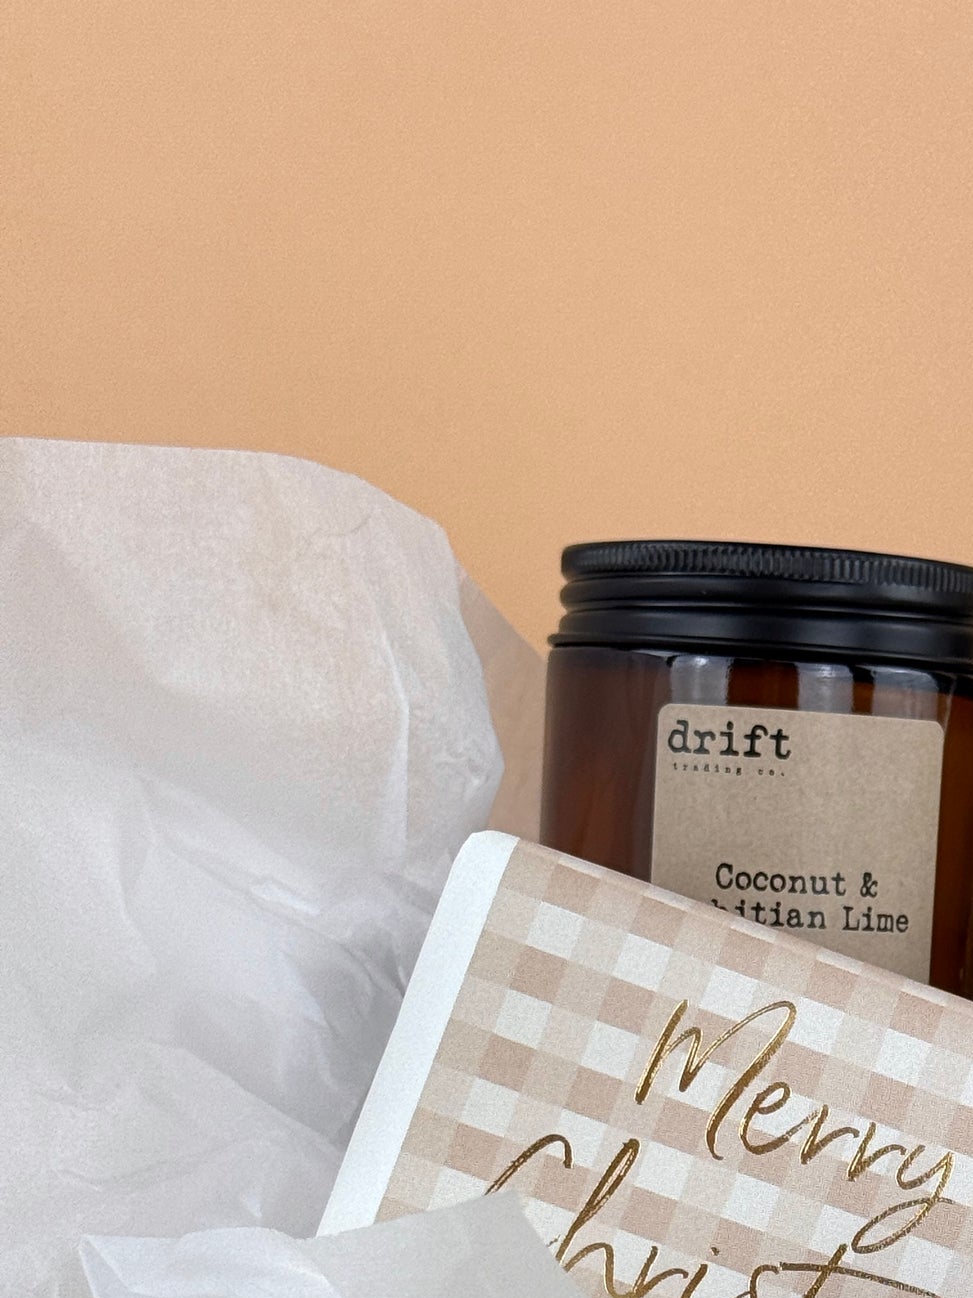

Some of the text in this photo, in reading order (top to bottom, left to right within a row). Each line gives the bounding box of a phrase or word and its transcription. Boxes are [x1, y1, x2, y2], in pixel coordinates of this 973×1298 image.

[667, 719, 792, 760] drift
[672, 762, 786, 777] trading co.
[715, 862, 879, 898] Coconut &
[711, 899, 910, 933] itian Lime
[636, 999, 956, 1255] Merry
